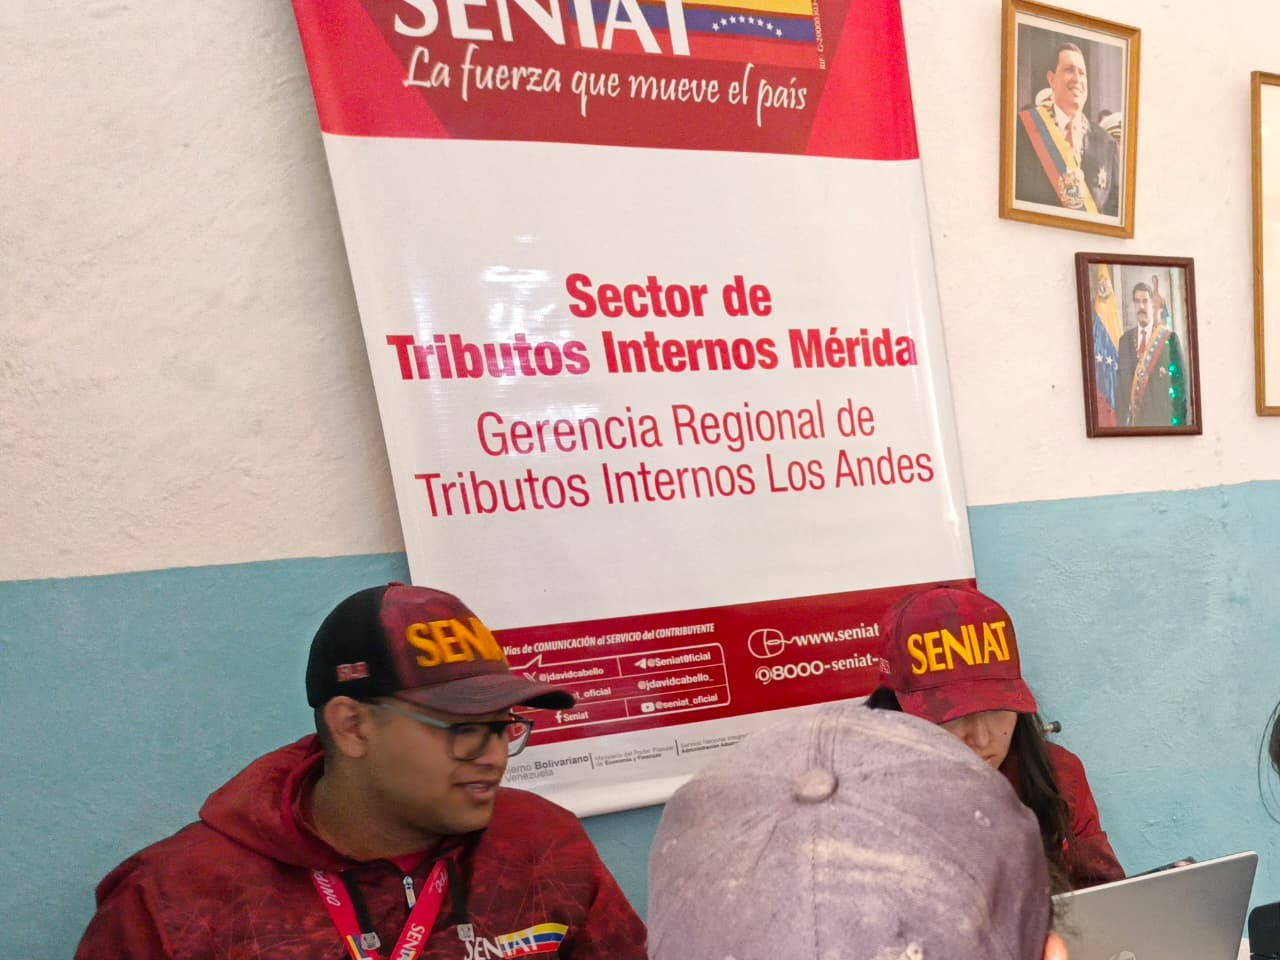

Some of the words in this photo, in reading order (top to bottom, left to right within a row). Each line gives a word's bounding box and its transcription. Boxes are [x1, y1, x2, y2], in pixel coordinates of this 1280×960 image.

[402, 45, 451, 89] La
[461, 44, 562, 101] fuerza
[571, 69, 620, 117] que
[628, 74, 720, 104] mueve
[728, 62, 751, 106] el
[756, 79, 808, 128] país
[565, 273, 709, 319] Sector
[722, 275, 773, 315] de
[386, 331, 591, 381] Tributos
[605, 330, 779, 375] Internos
[788, 326, 918, 370] Mérida
[477, 406, 663, 458] Gerencia
[671, 400, 827, 453] Regional
[837, 397, 876, 436] de
[414, 469, 591, 519] Tributos
[602, 460, 756, 504] Internos
[766, 452, 826, 492] Los
[834, 446, 935, 488] Andes
[503, 644, 521, 656] Vías
[522, 644, 533, 653] de
[533, 635, 597, 653] COMUNICACIÓN
[597, 636, 606, 646] al
[606, 629, 642, 645] SERVICIO
[642, 629, 655, 641] del
[655, 623, 716, 640] CONTRIBUYENTE
[907, 621, 1011, 676] SENIAT
[538, 667, 605, 683] @jdavidcabello
[573, 687, 612, 700] t_oficial
[563, 711, 589, 723] Seniat
[655, 693, 719, 711] @seniat_oficial
[533, 755, 590, 770] Bolivariano
